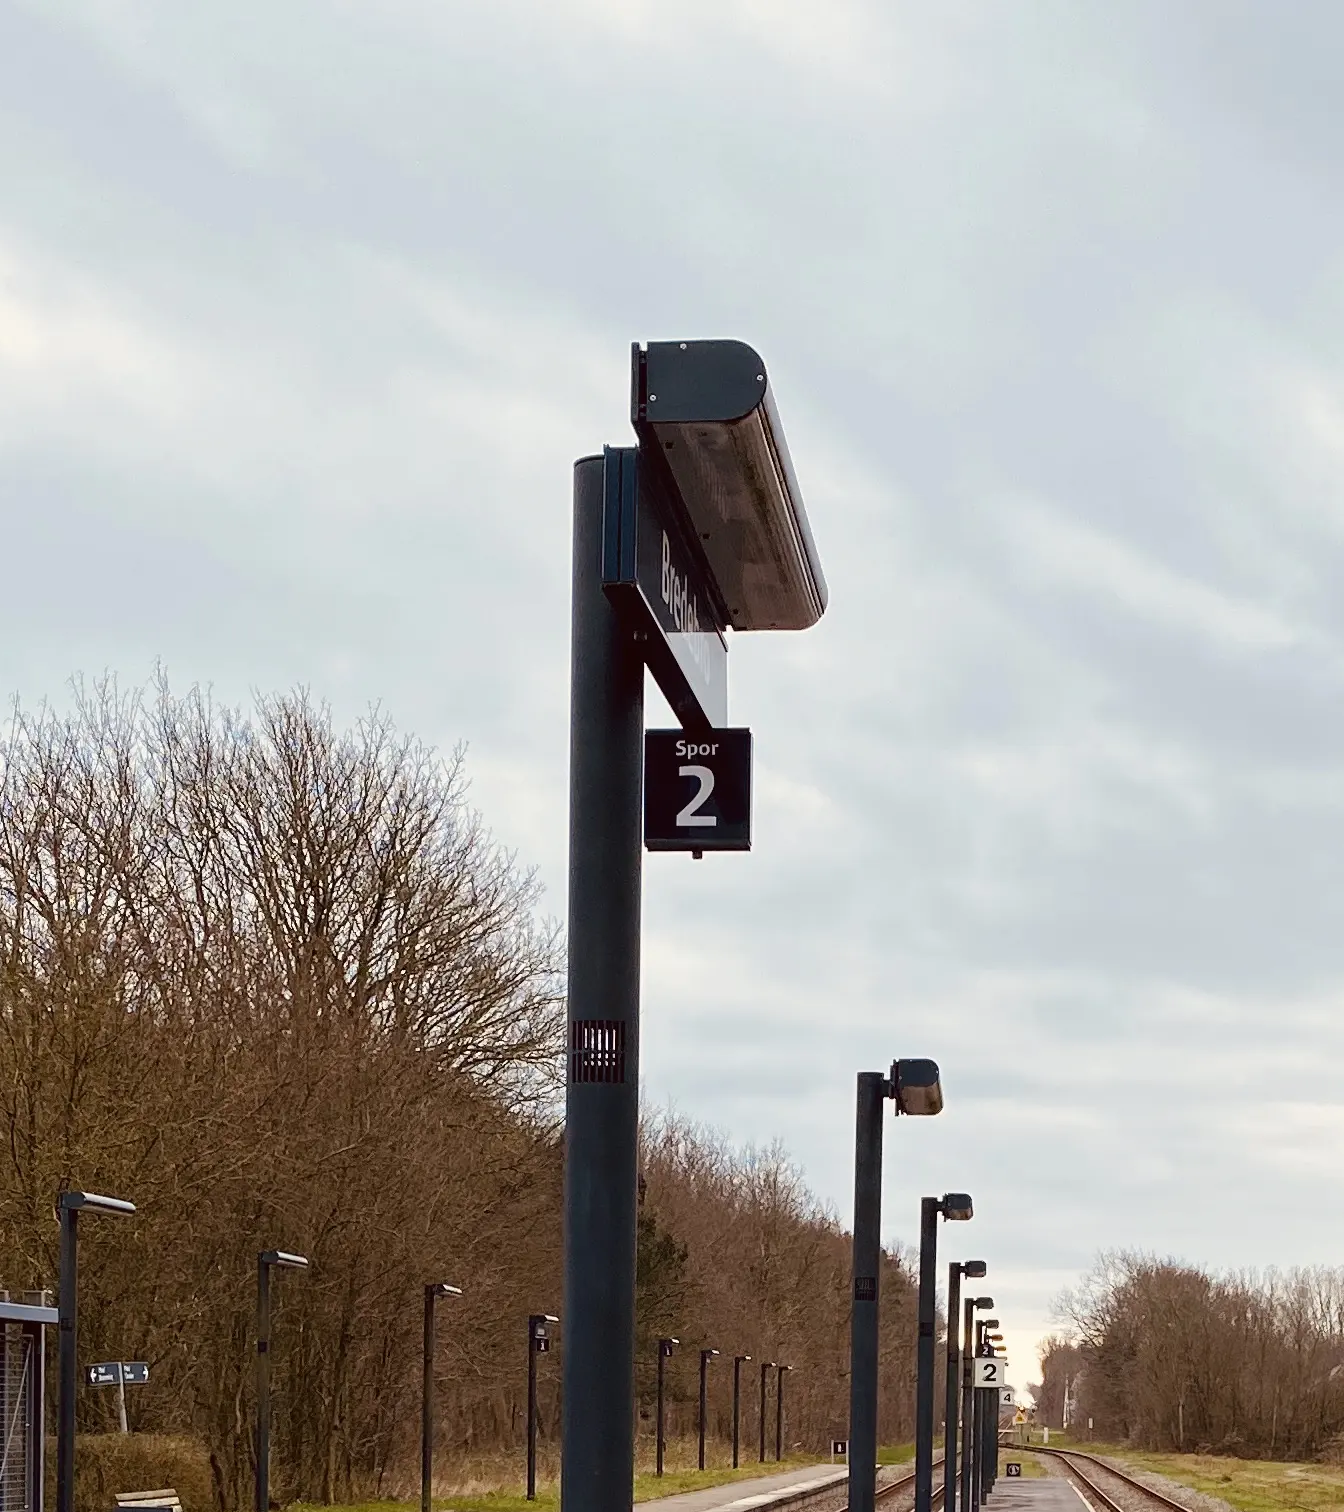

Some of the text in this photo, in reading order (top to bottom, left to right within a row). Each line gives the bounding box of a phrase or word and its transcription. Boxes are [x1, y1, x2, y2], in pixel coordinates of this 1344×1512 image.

[675, 740, 719, 760] Spor
[676, 765, 717, 827] 2
[982, 1346, 989, 1355] 2
[983, 1363, 997, 1382] 2
[1003, 1393, 1011, 1402] 4
